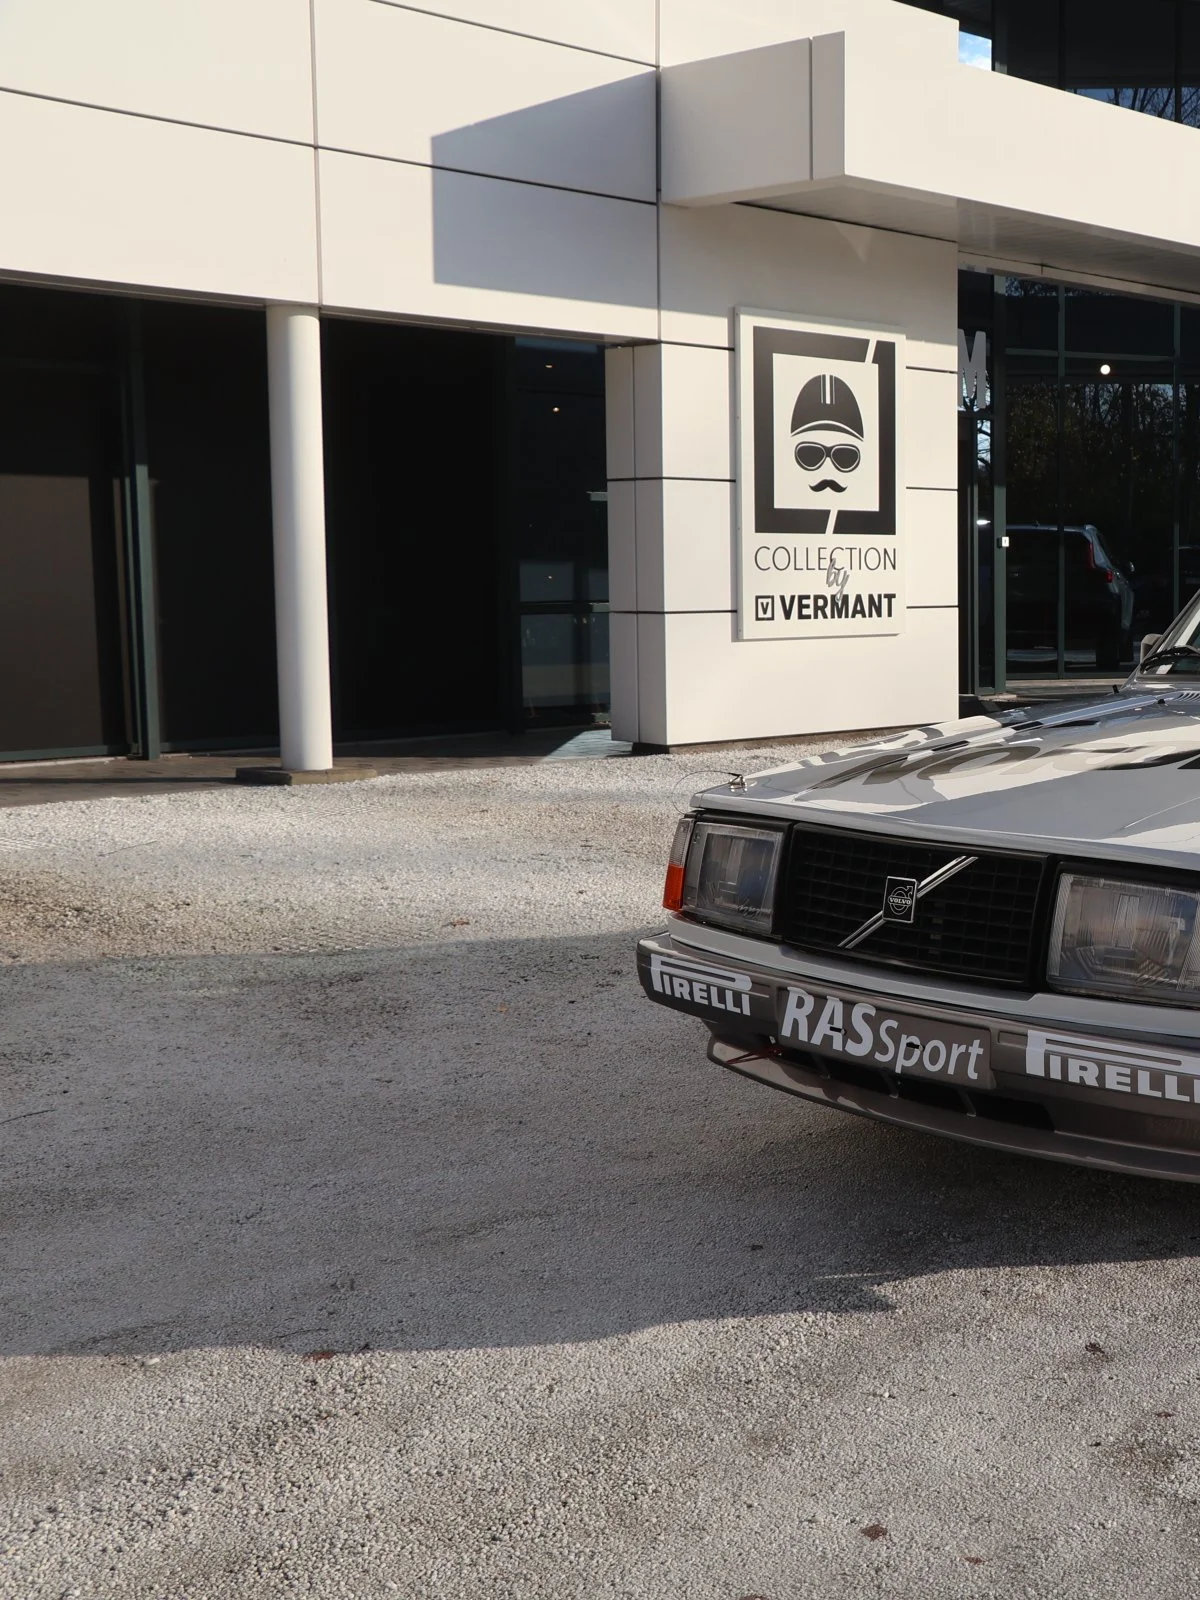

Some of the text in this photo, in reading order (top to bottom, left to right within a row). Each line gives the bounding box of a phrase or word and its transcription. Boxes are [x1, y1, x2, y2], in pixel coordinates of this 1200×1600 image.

[754, 546, 896, 571] COLLECTION
[825, 558, 849, 602] by
[779, 593, 897, 620] VERMANT
[889, 897, 911, 905] VOLVO
[650, 953, 752, 1016] PIRELLI
